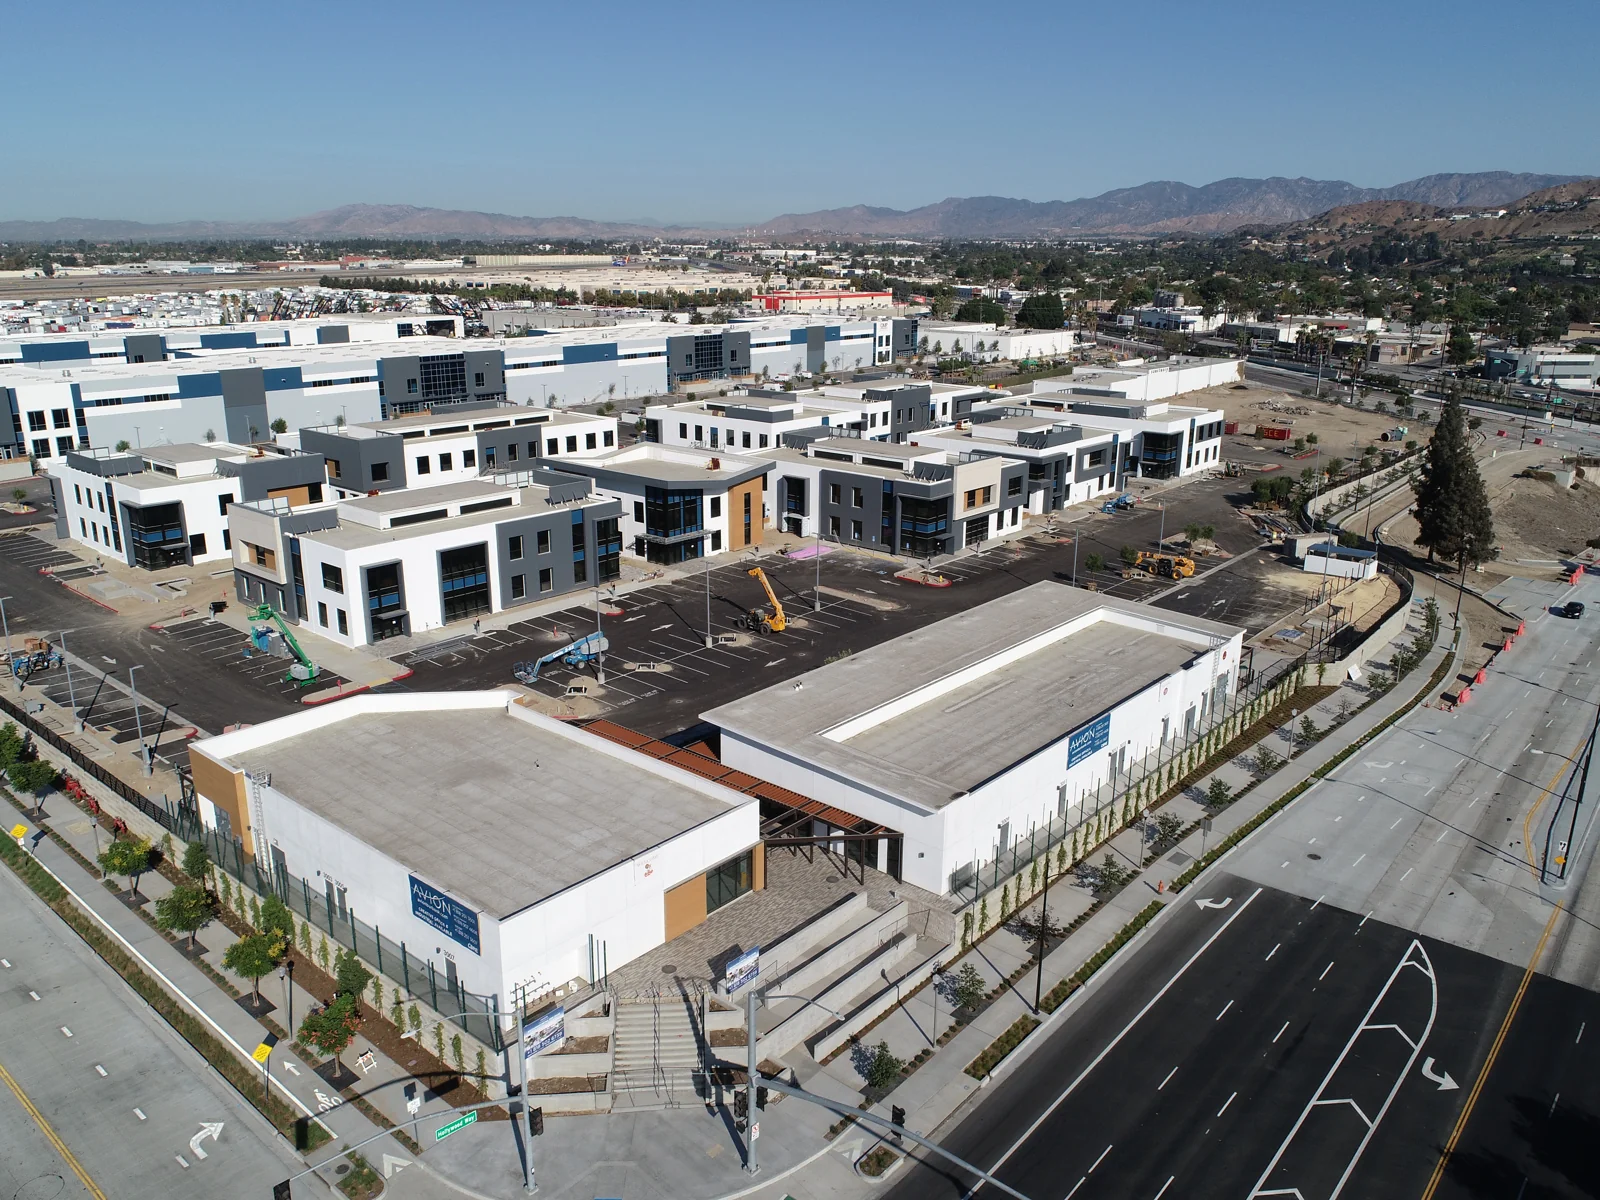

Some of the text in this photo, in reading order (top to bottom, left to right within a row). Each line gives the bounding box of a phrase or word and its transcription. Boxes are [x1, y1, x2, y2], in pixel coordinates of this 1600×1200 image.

[1070, 727, 1095, 751] AVION
[412, 884, 452, 916] AVION
[438, 1115, 475, 1137] Hollywood Way
